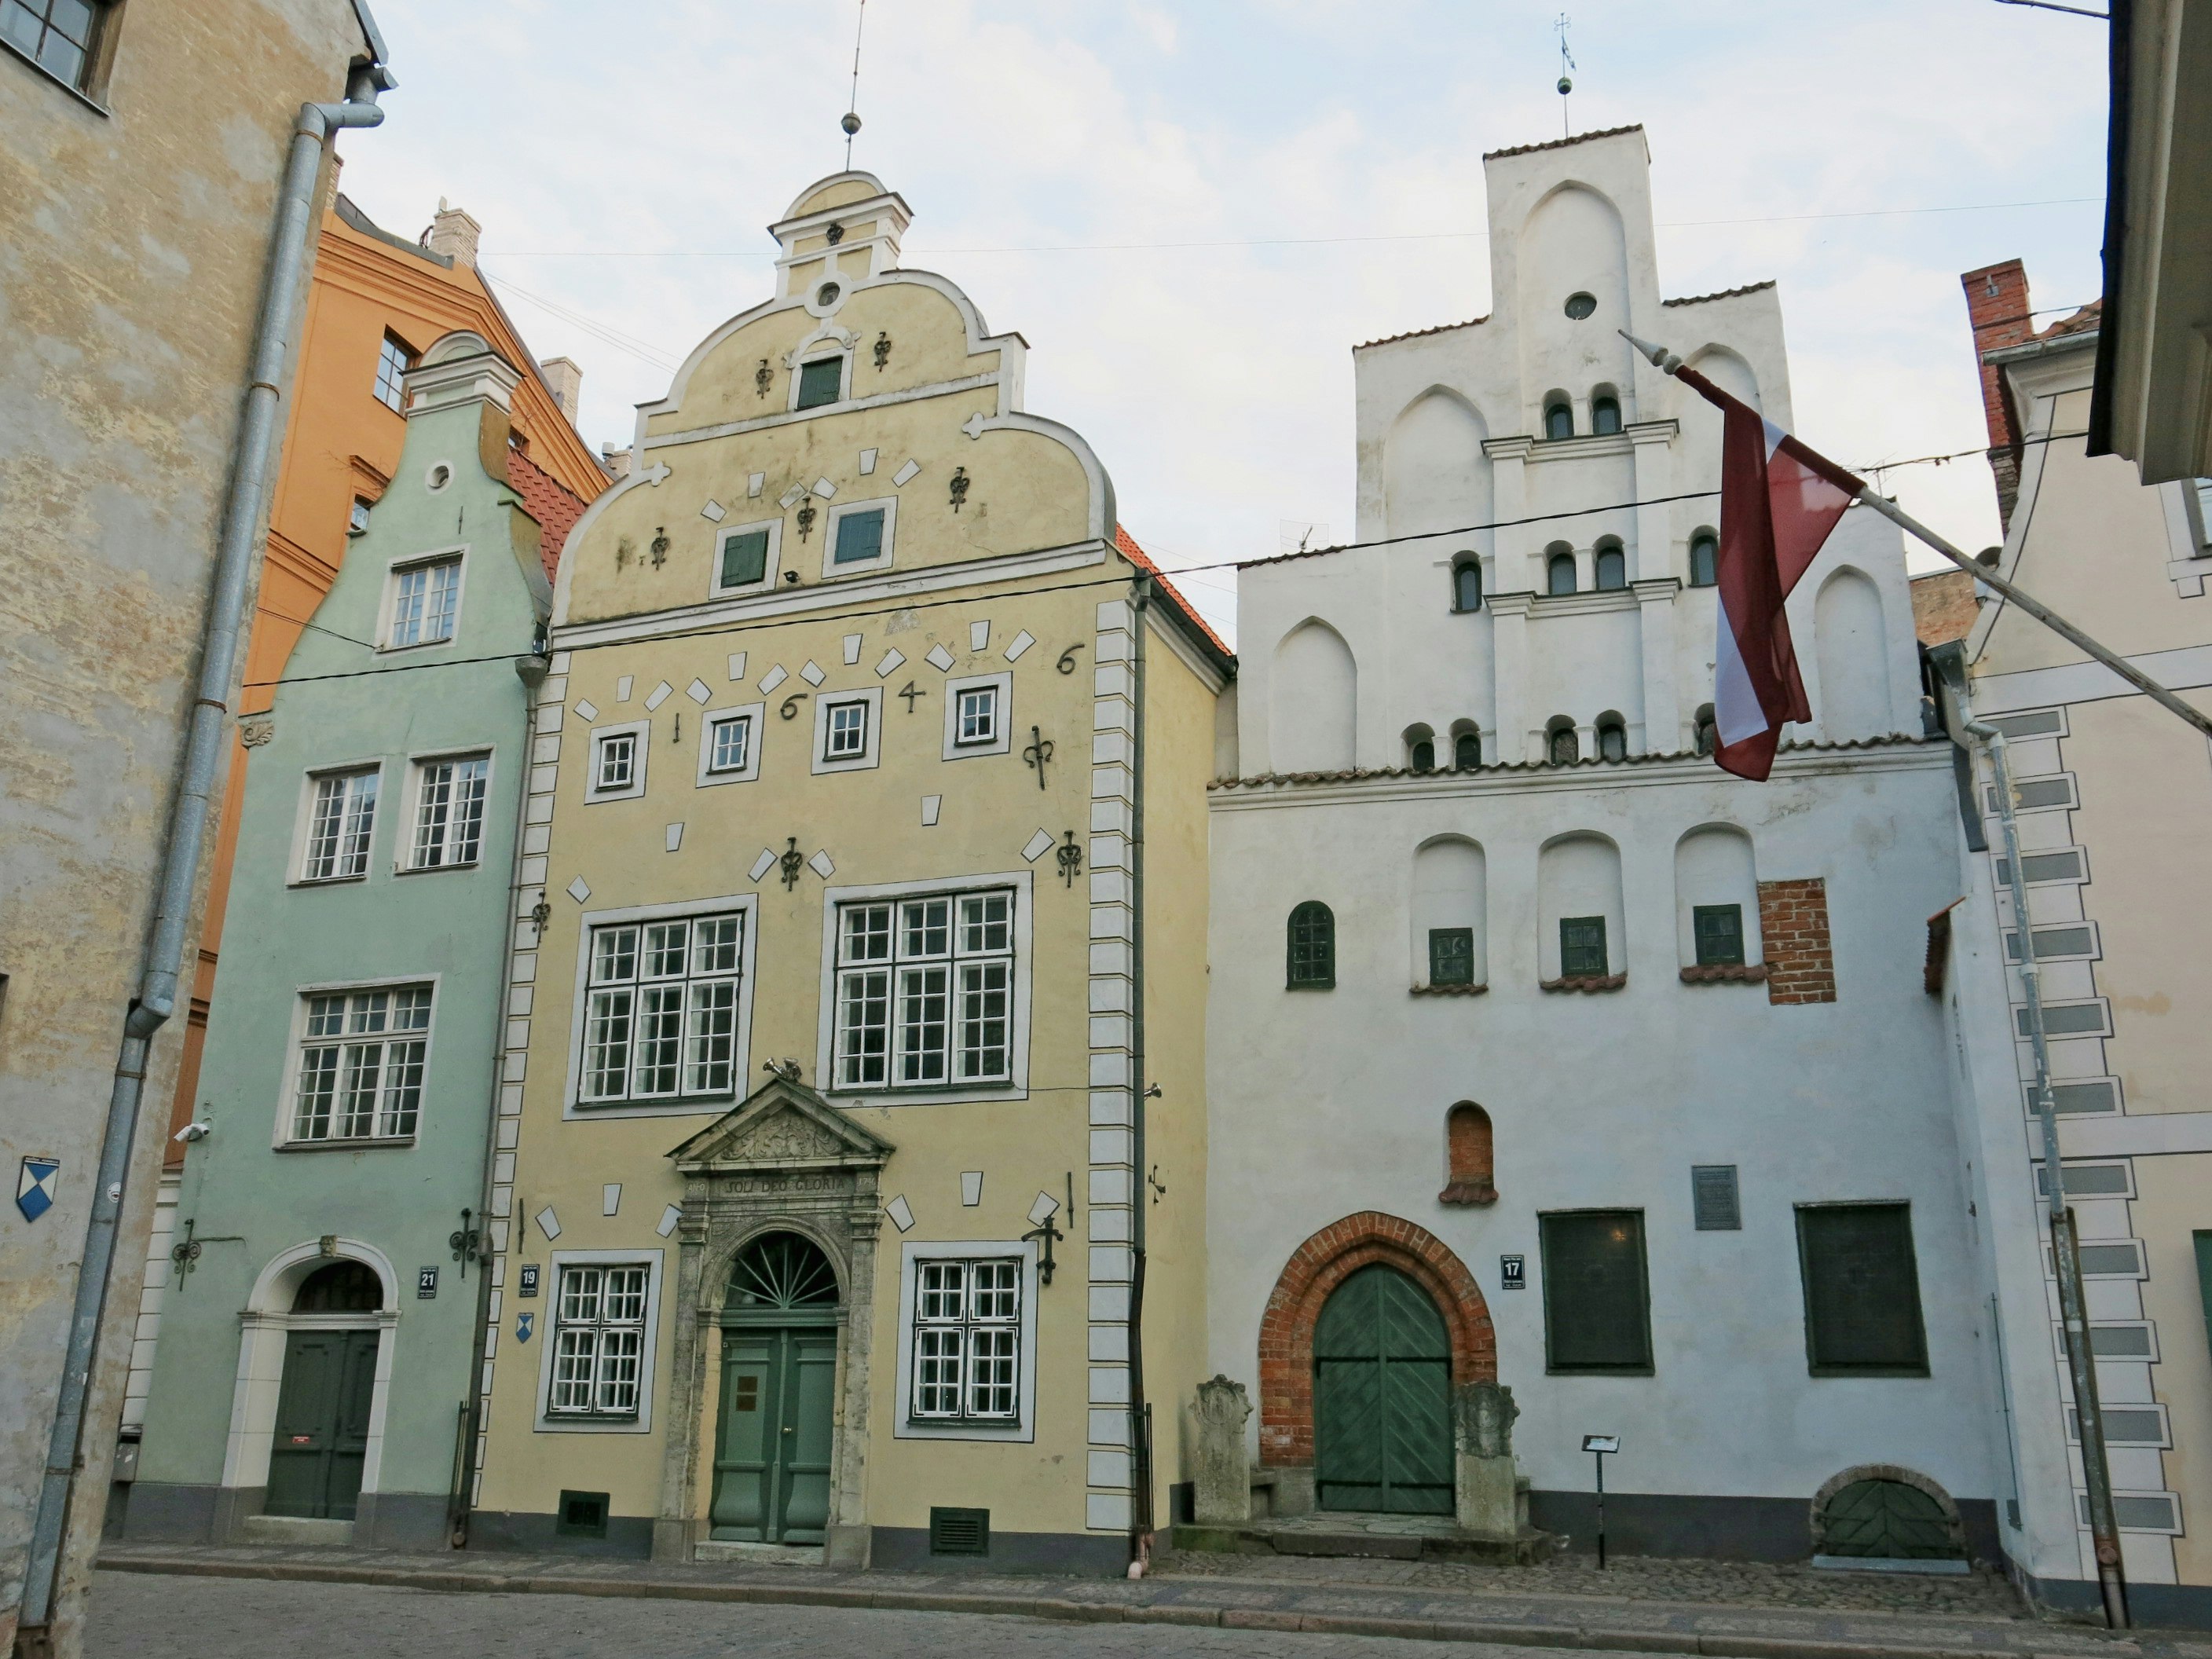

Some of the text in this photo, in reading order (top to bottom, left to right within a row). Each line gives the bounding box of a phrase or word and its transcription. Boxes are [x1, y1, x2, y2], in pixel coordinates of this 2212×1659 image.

[780, 693, 808, 720] 6
[898, 680, 926, 713] 4
[1057, 643, 1086, 675] 6
[761, 1180, 788, 1192] DEO
[796, 1178, 845, 1191] GLORIA
[1505, 1262, 1520, 1276] 17
[421, 1273, 434, 1287] 21
[523, 1271, 536, 1284] 19
